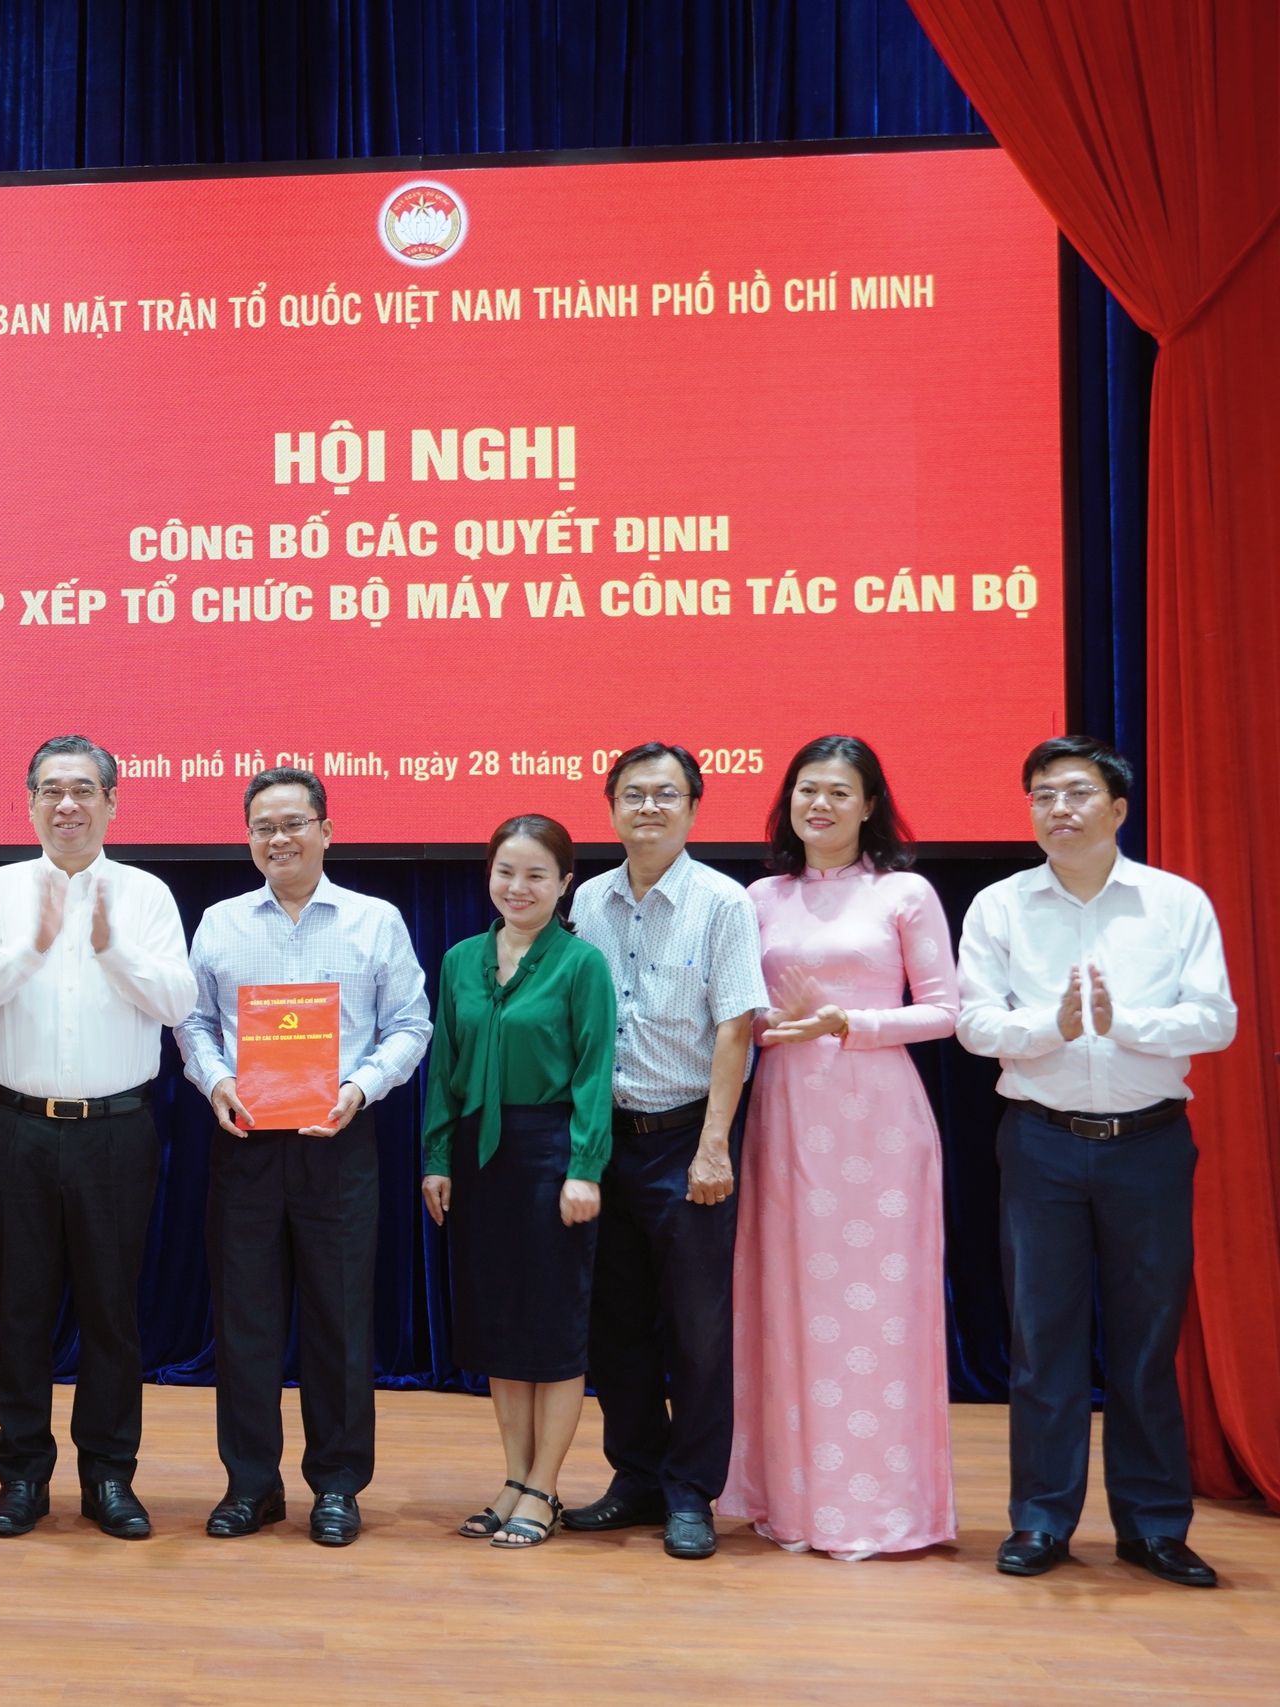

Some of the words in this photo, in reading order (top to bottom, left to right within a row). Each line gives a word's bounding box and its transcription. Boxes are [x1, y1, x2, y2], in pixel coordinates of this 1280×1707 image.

[63, 295, 128, 339] MẶT
[137, 291, 217, 337] TRẬN
[228, 281, 267, 329] TỔ
[279, 282, 362, 329] QUỐC
[374, 284, 440, 330] VIỆT
[451, 288, 521, 322] NAM
[532, 279, 638, 320] THÀNH
[652, 270, 715, 316] PHỐ
[728, 269, 771, 314] HỒ
[784, 271, 838, 313] CHÍ
[850, 274, 934, 311] MINH
[274, 419, 386, 495] HỘI
[411, 425, 576, 491] NGHỊ
[129, 518, 254, 563] CÔNG
[269, 509, 331, 559] BỐ
[345, 513, 438, 558] CÁC
[454, 506, 600, 561] QUYẾT
[613, 515, 729, 561] ĐỊNH
[19, 577, 107, 626] XẾP
[120, 573, 178, 624] TỔ
[191, 578, 313, 623] CHỨC
[329, 576, 390, 628] BỘ
[406, 574, 510, 620] MÁY
[523, 573, 586, 618] VÀ
[600, 572, 731, 617] CÔNG
[745, 569, 837, 615] TÁC
[854, 567, 955, 614] CÁN
[972, 565, 1038, 619] BỘ
[114, 752, 171, 778] hành
[181, 749, 224, 783] phố
[234, 749, 266, 777] Hồ
[323, 751, 390, 780] Minh,
[398, 750, 459, 782] ngày
[468, 750, 500, 776] 28
[509, 750, 582, 781] tháng
[698, 748, 763, 774] 2025
